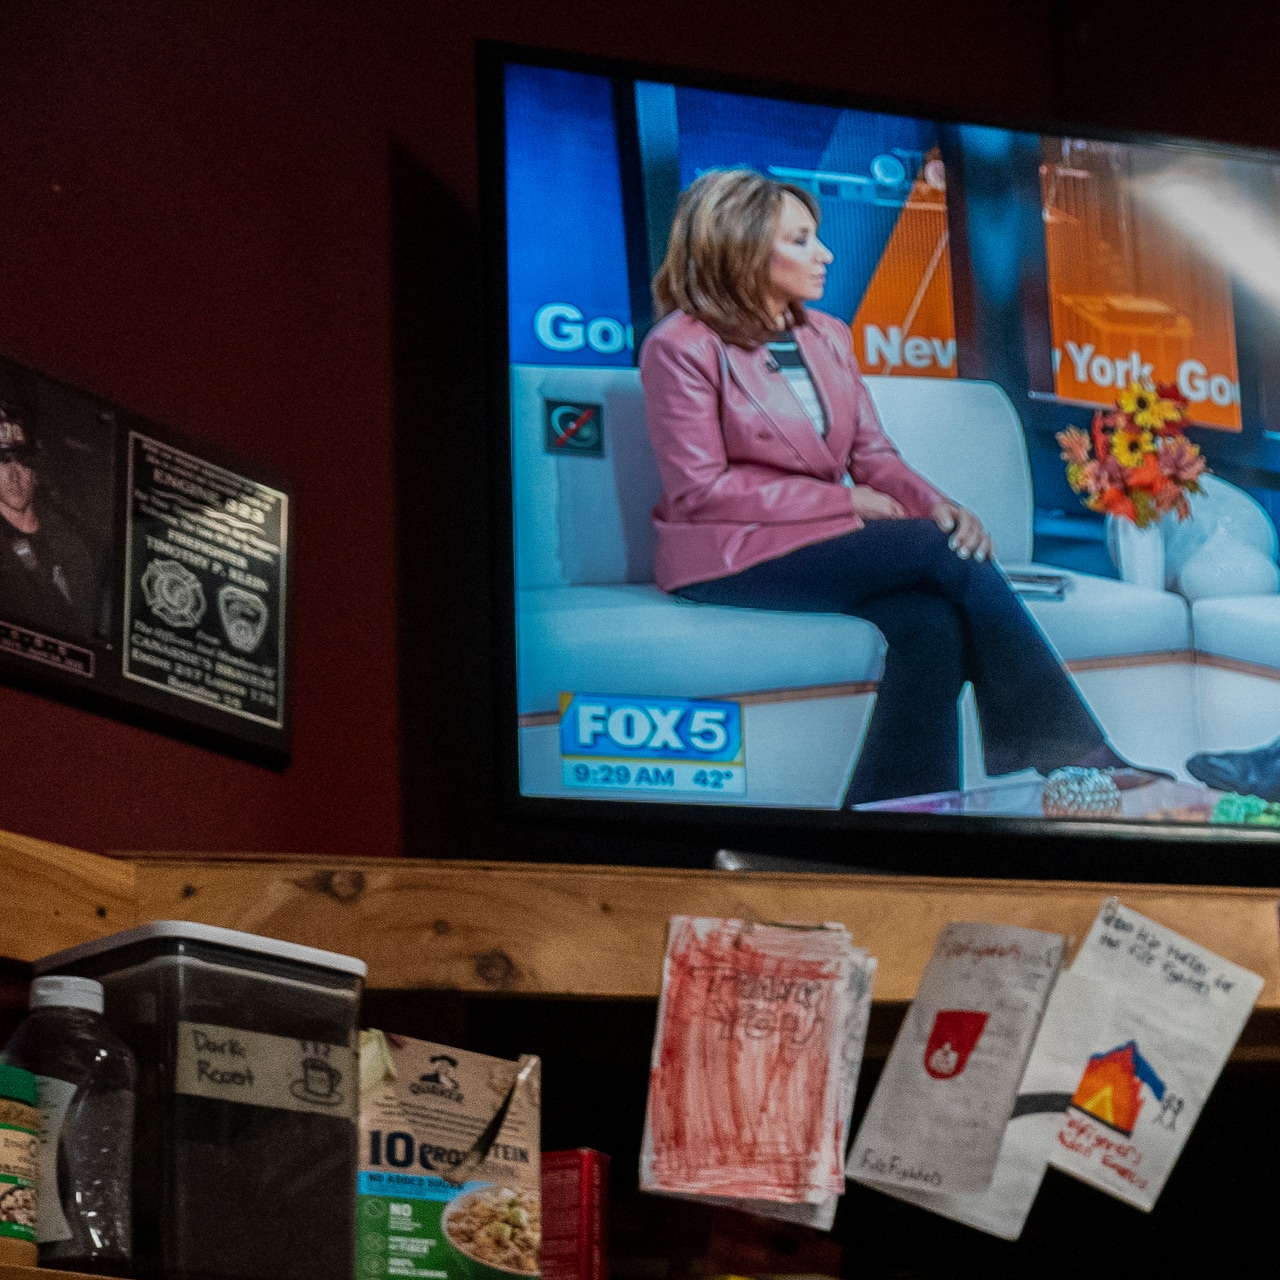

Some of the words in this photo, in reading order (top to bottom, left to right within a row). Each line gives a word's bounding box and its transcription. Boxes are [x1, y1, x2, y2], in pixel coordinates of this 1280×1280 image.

[577, 705, 683, 752] FOX
[688, 706, 728, 753] 5
[574, 763, 630, 785] 9:29
[635, 765, 675, 787] AM
[191, 1029, 247, 1060] Dark
[196, 1059, 256, 1088] Roast
